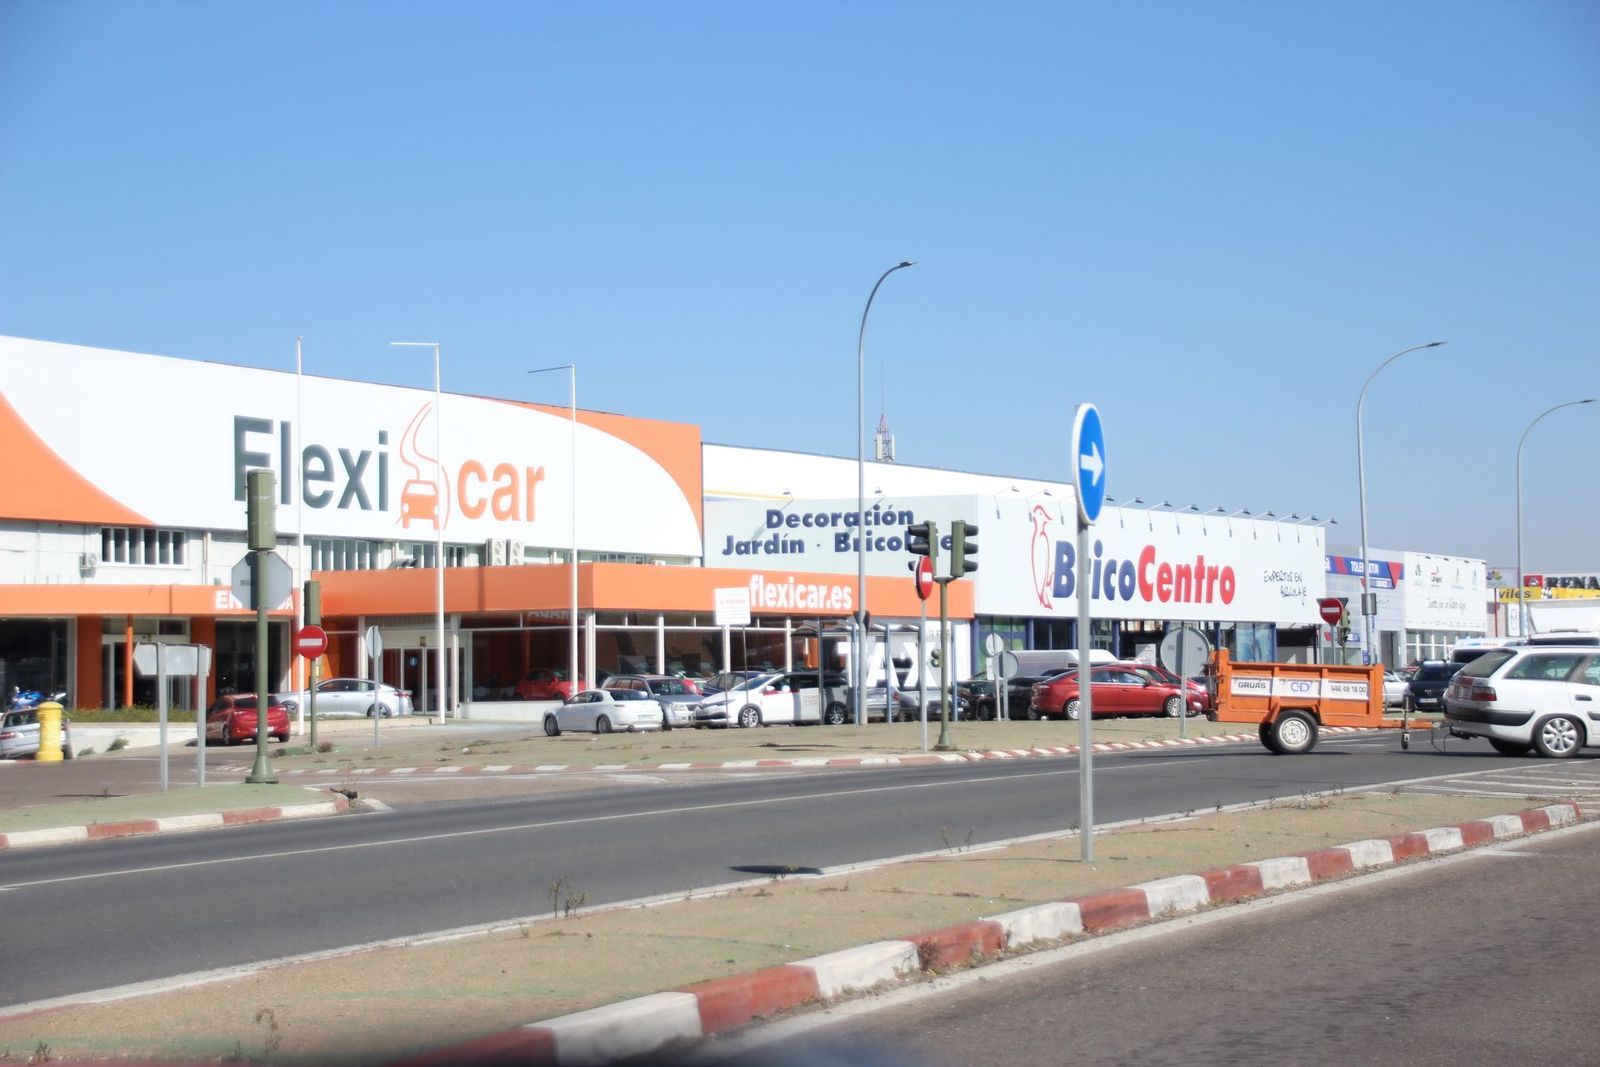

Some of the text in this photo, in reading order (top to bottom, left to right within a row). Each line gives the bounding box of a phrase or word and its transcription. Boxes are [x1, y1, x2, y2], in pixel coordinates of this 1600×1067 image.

[233, 414, 545, 523] Flexi car
[766, 504, 914, 529] Decoración
[722, 532, 805, 556] Jardín
[750, 574, 853, 609] flexicar.es
[1237, 681, 1266, 690] GRUAS
